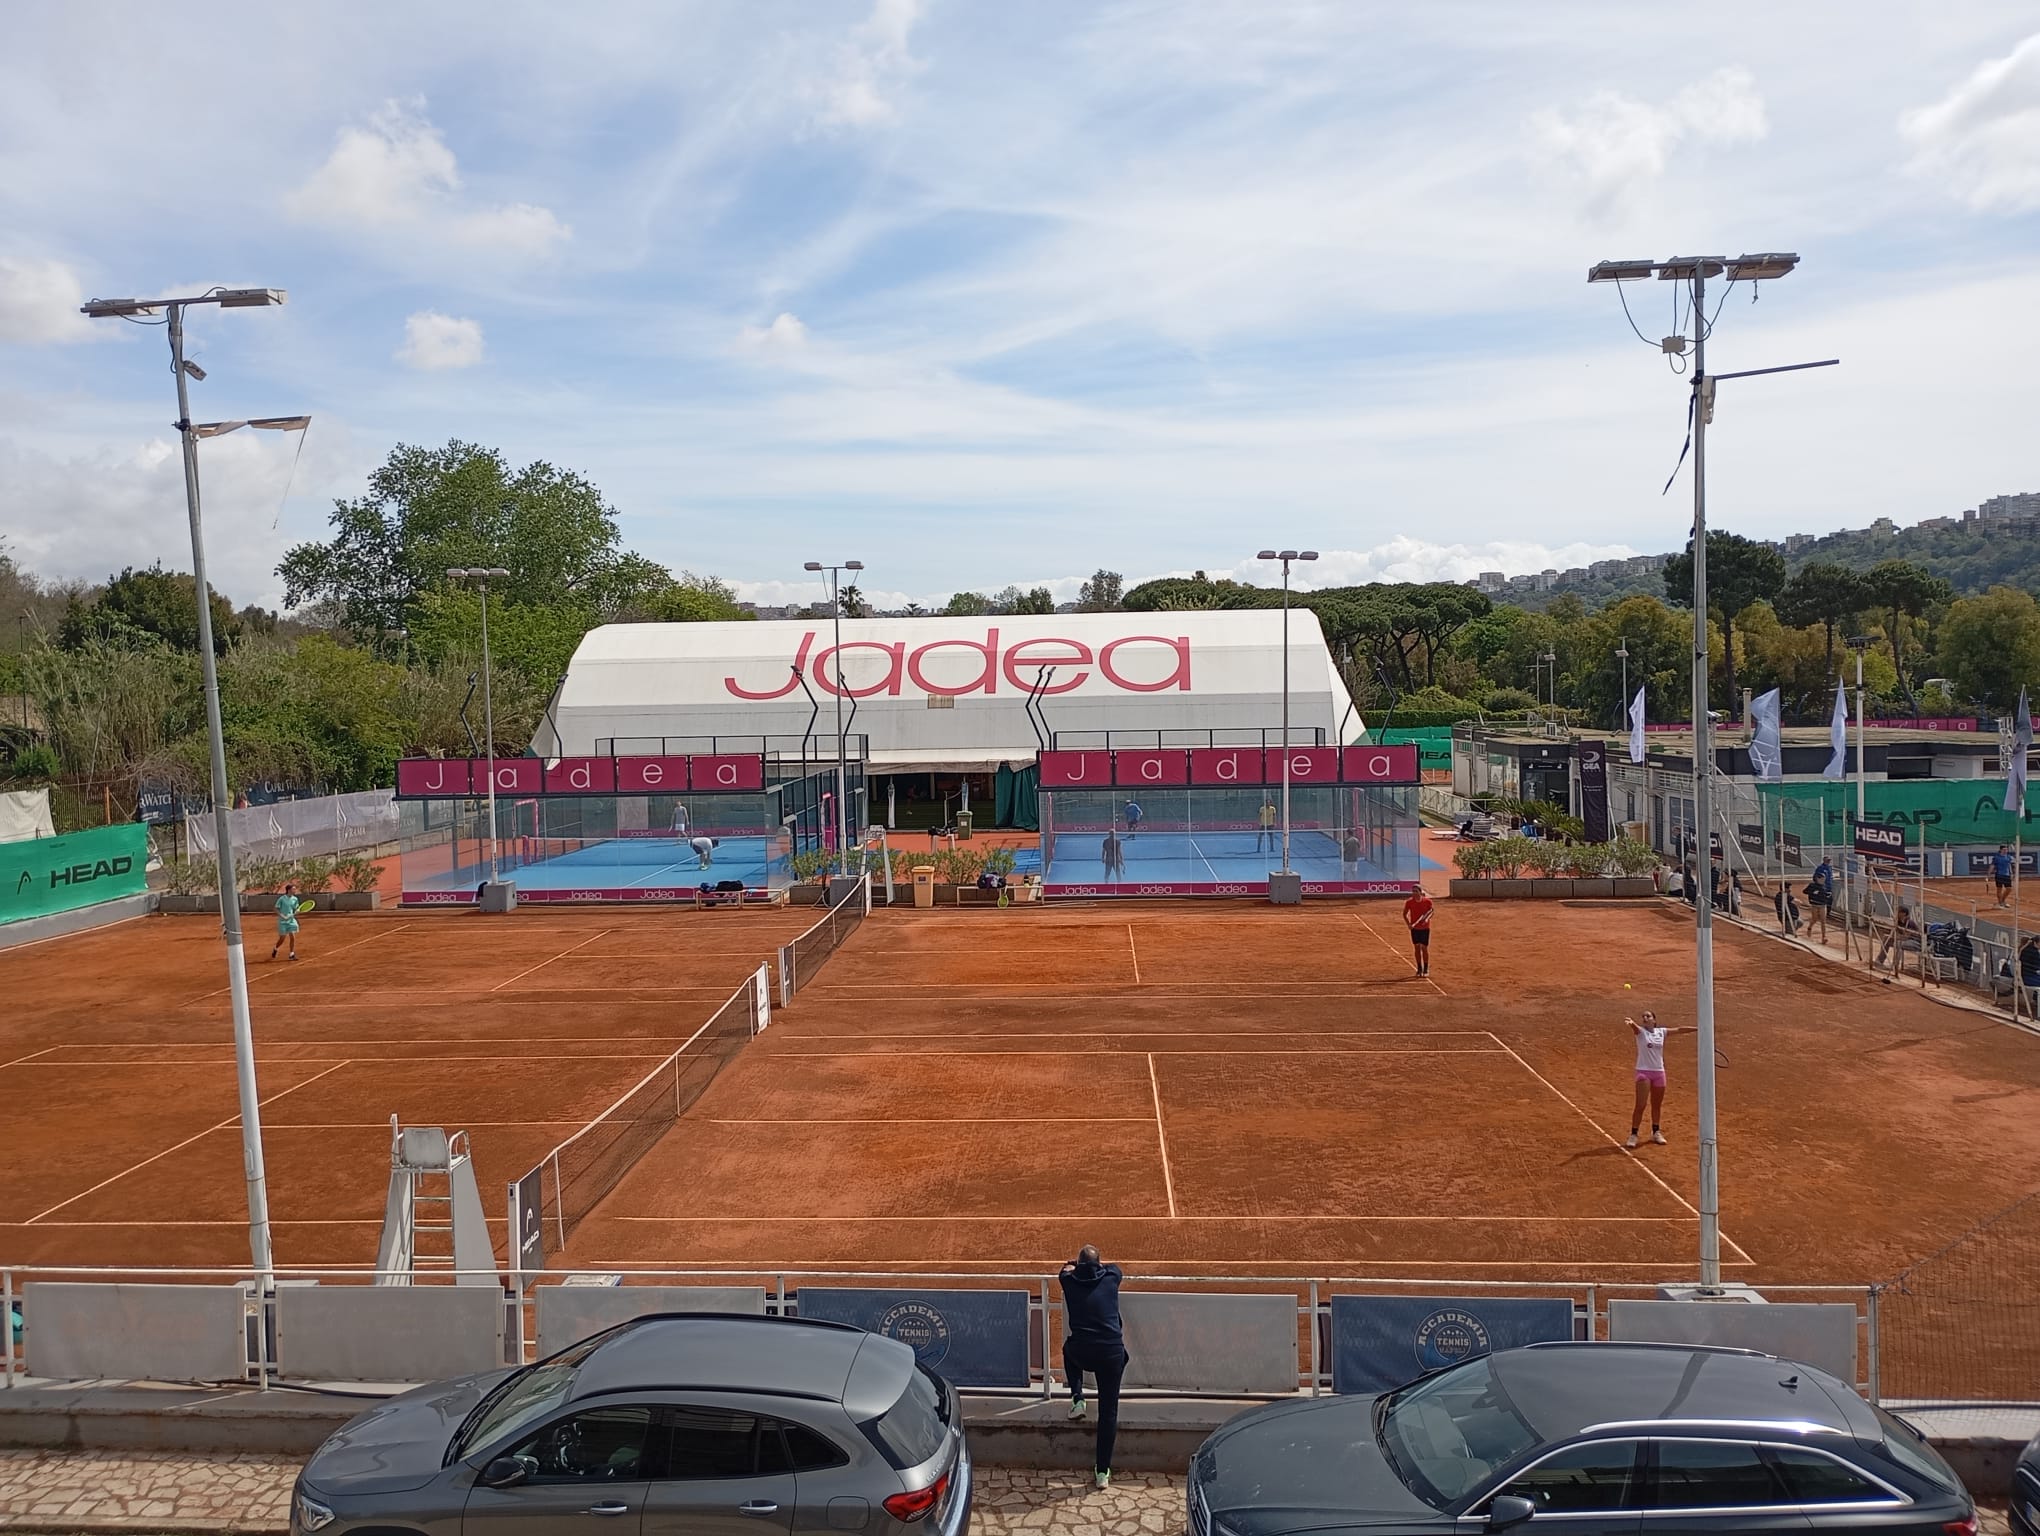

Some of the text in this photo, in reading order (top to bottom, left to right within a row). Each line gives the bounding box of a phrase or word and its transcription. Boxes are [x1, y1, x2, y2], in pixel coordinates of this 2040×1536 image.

[724, 628, 1191, 700] Jadea
[1741, 834, 1761, 845] HEAD
[1855, 826, 1902, 846] HEAD
[50, 856, 132, 889] HEAD
[1060, 885, 1097, 895] Jadea
[1136, 884, 1172, 894] Jadea
[1211, 883, 1248, 894] Jadea
[1363, 882, 1401, 893] Jadea
[421, 892, 457, 902] Jadea
[567, 890, 602, 900] Jadea
[640, 889, 675, 899] Jadea
[880, 1305, 947, 1338] ACCADEMIA
[898, 1328, 930, 1337] TENNIS
[1418, 1313, 1488, 1347] ACCADEMIA
[1436, 1337, 1470, 1346] TENNIS
